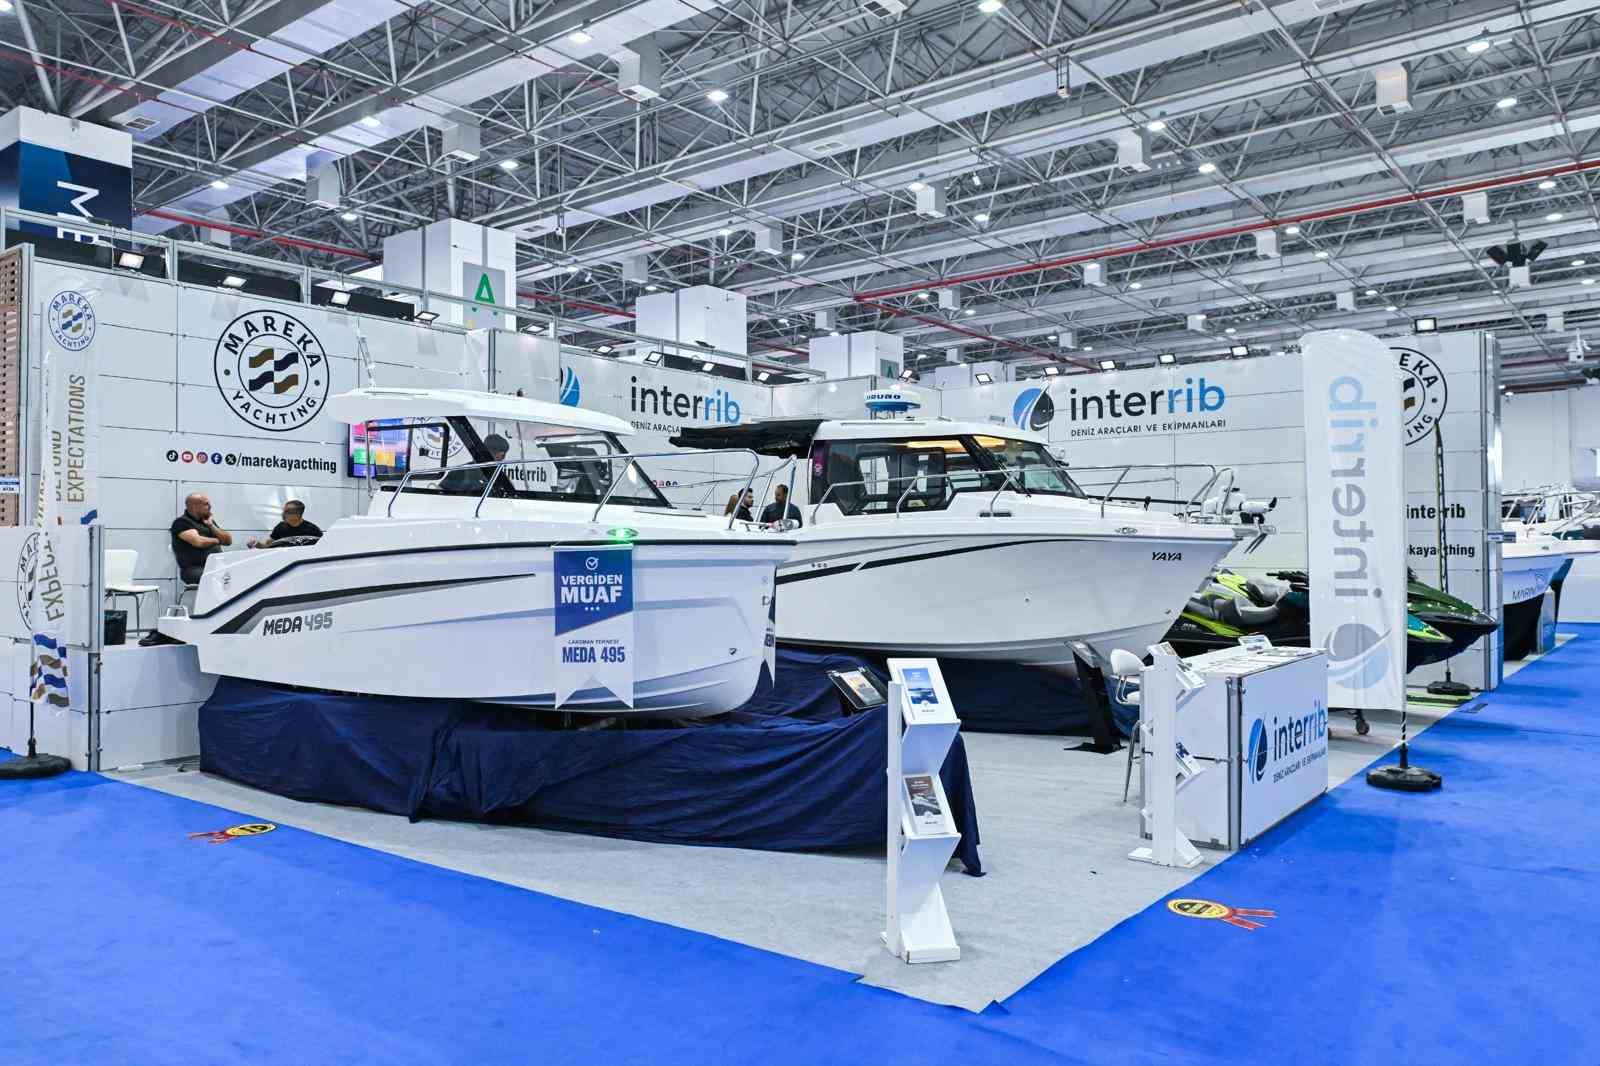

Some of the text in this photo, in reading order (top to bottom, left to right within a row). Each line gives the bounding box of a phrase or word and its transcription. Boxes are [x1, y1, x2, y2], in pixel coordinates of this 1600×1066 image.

[224, 316, 322, 368] MAREKA
[1399, 353, 1438, 388] EKA
[232, 391, 317, 424] YACHTING
[631, 376, 741, 423] interrib
[1070, 378, 1225, 421] interrib
[67, 374, 86, 503] EXPECTATIONS
[1071, 428, 1095, 437] DENİZ
[1097, 425, 1142, 436] ARAÇLARI
[1146, 423, 1158, 431] VE
[236, 453, 337, 474] /marekayacthing
[1406, 504, 1466, 519] interib
[1152, 551, 1182, 561] YAYA
[561, 573, 623, 585] VERGİDEN
[560, 586, 623, 604] MUAF
[263, 611, 333, 636] MEDA 495
[562, 646, 626, 663] MEDA 495
[1273, 699, 1326, 762] interrib
